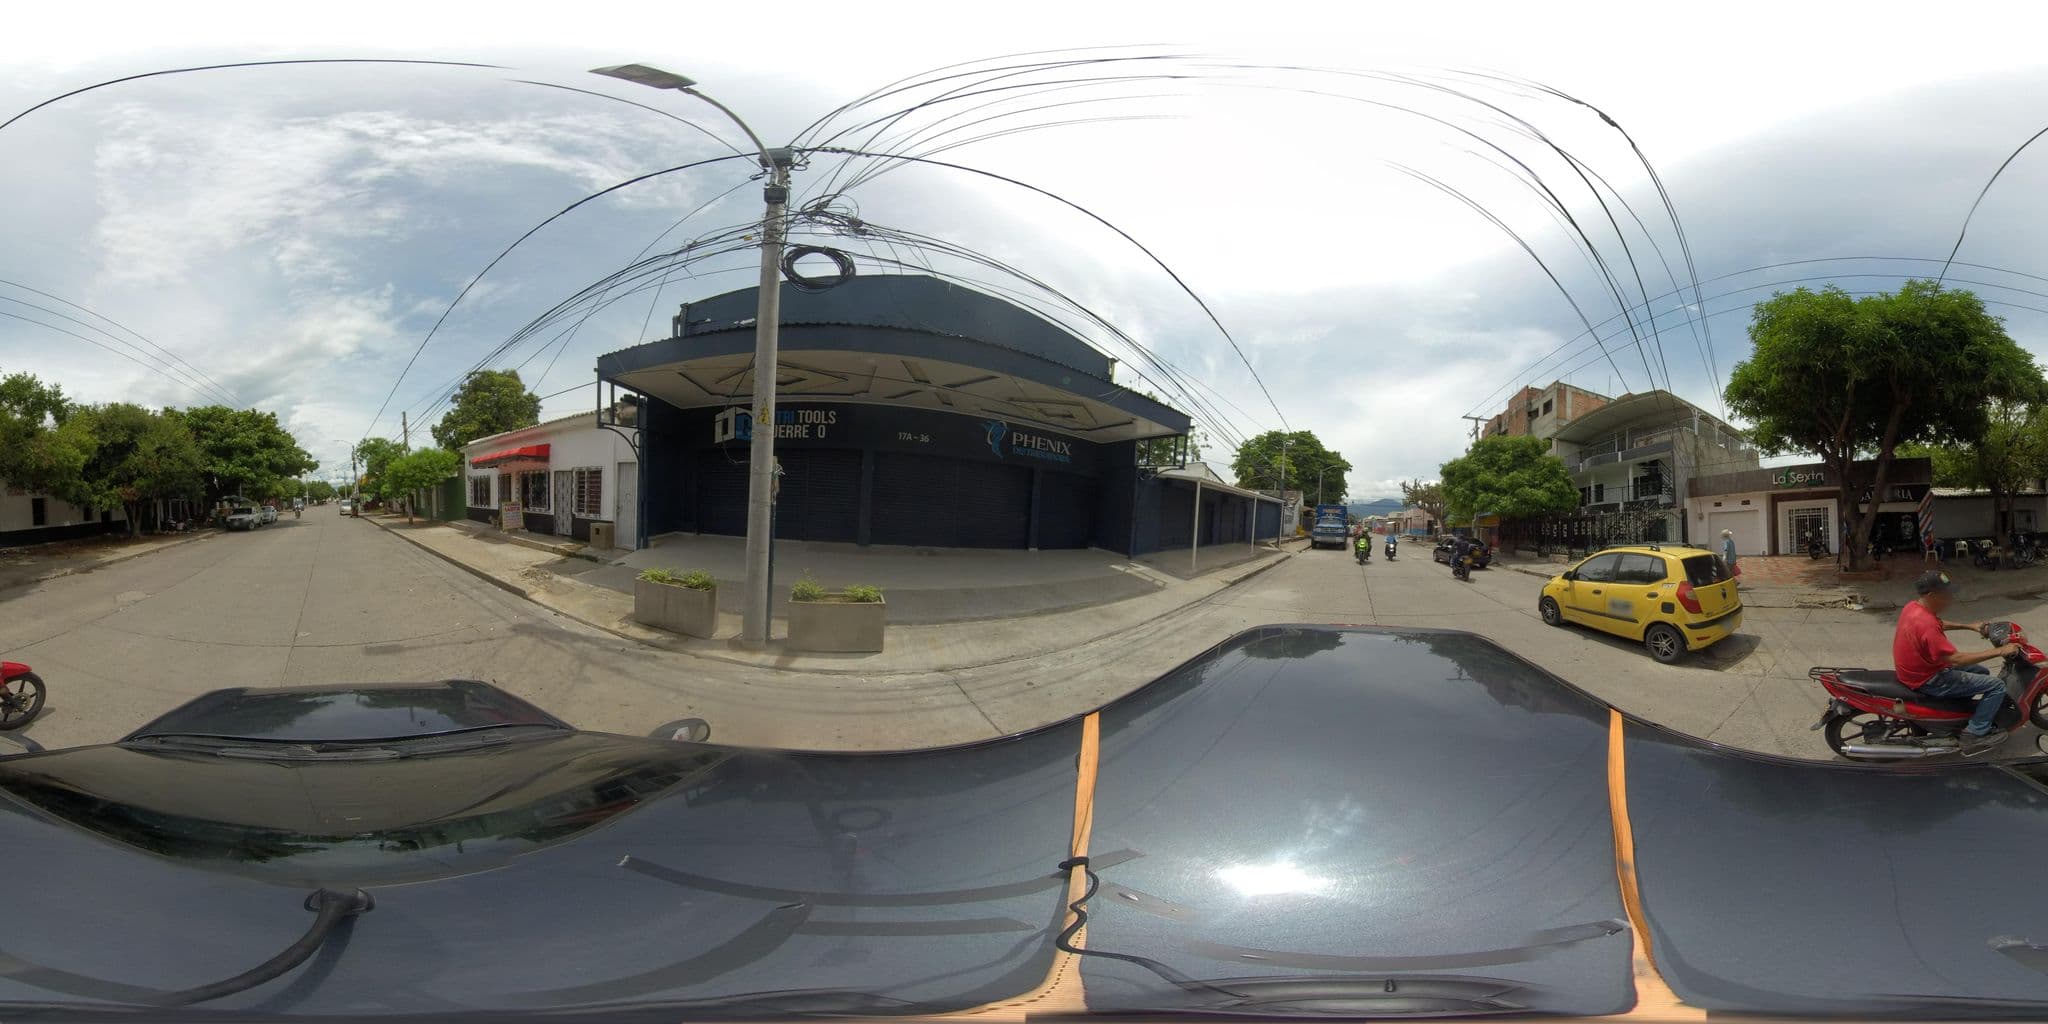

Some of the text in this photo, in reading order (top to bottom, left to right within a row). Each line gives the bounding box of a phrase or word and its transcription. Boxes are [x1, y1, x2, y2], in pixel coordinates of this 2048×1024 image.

[797, 410, 837, 424] TOOLS
[1012, 431, 1072, 456] PHENIX
[1772, 473, 1787, 485] La
[1789, 470, 1825, 484] Sexta
